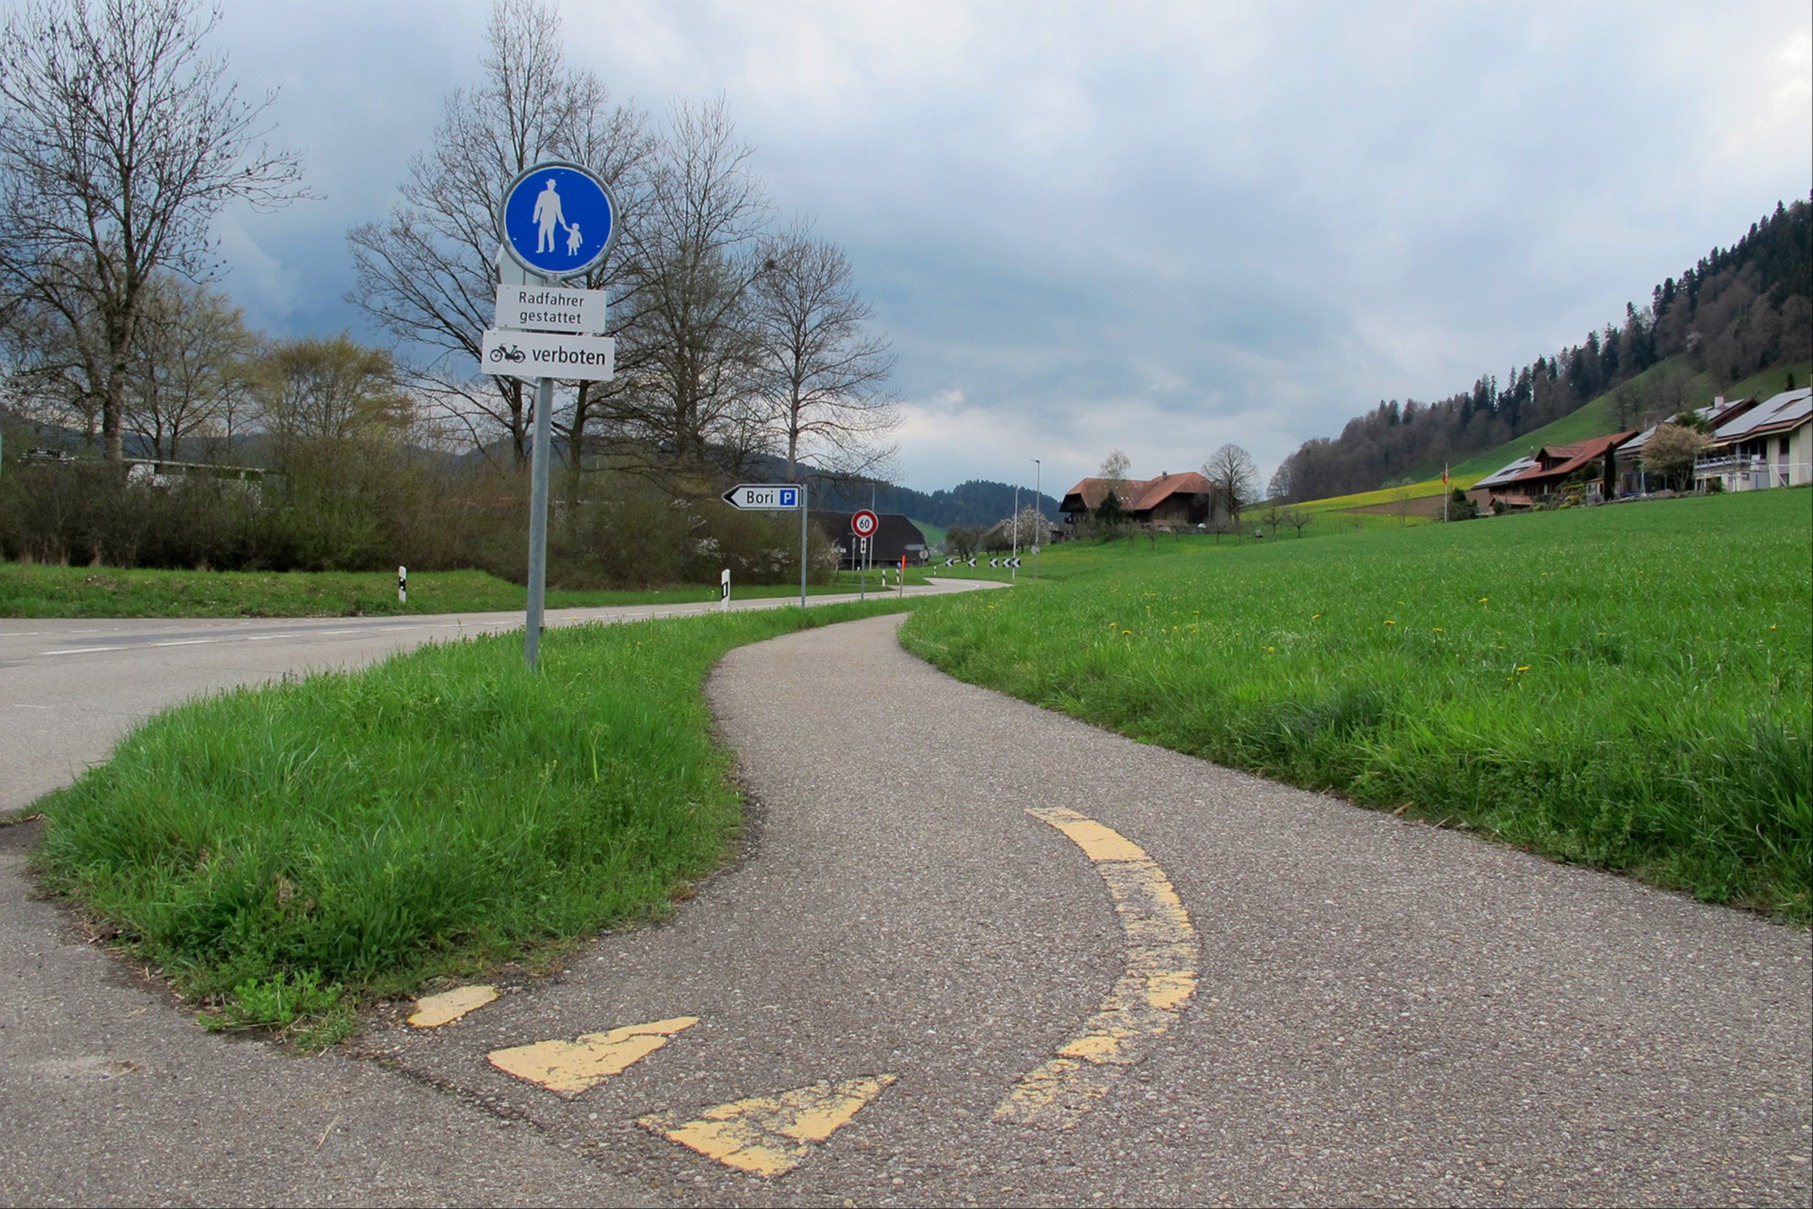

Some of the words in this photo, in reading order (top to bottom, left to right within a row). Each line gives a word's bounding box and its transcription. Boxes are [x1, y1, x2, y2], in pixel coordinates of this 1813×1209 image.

[519, 291, 584, 307] Radfahrer
[520, 311, 581, 324] gestattet
[532, 346, 606, 365] verboten
[747, 490, 773, 504] Bori
[783, 491, 793, 504] P
[859, 519, 871, 529] 60
